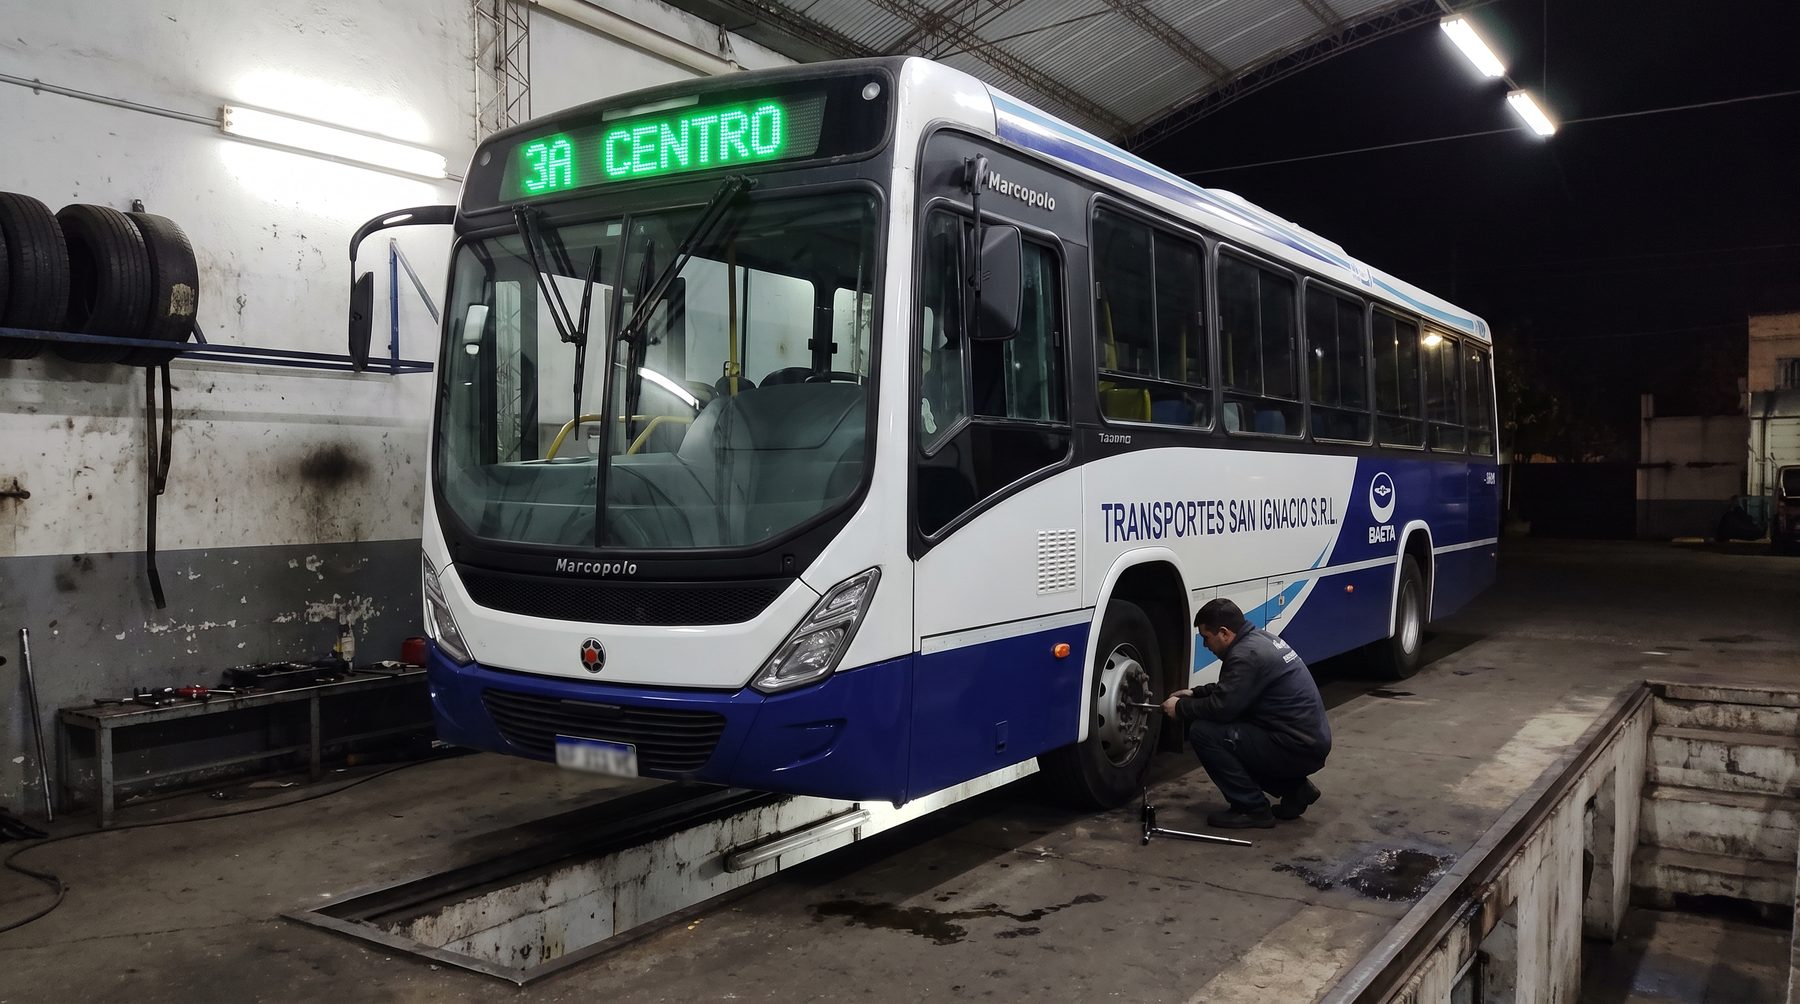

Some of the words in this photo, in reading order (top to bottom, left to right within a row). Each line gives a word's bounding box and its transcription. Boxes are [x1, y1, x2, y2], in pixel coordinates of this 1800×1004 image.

[525, 139, 572, 191] 3A
[605, 104, 782, 177] CENTRO
[988, 170, 1057, 211] Marcopolo
[1101, 499, 1225, 543] TRANSPORTES
[1229, 499, 1256, 533] SAN
[1260, 497, 1308, 531] IGNACIO
[1310, 497, 1338, 527] S.R.L.
[1368, 524, 1396, 544] BAETA
[555, 558, 638, 577] Marcopolo
